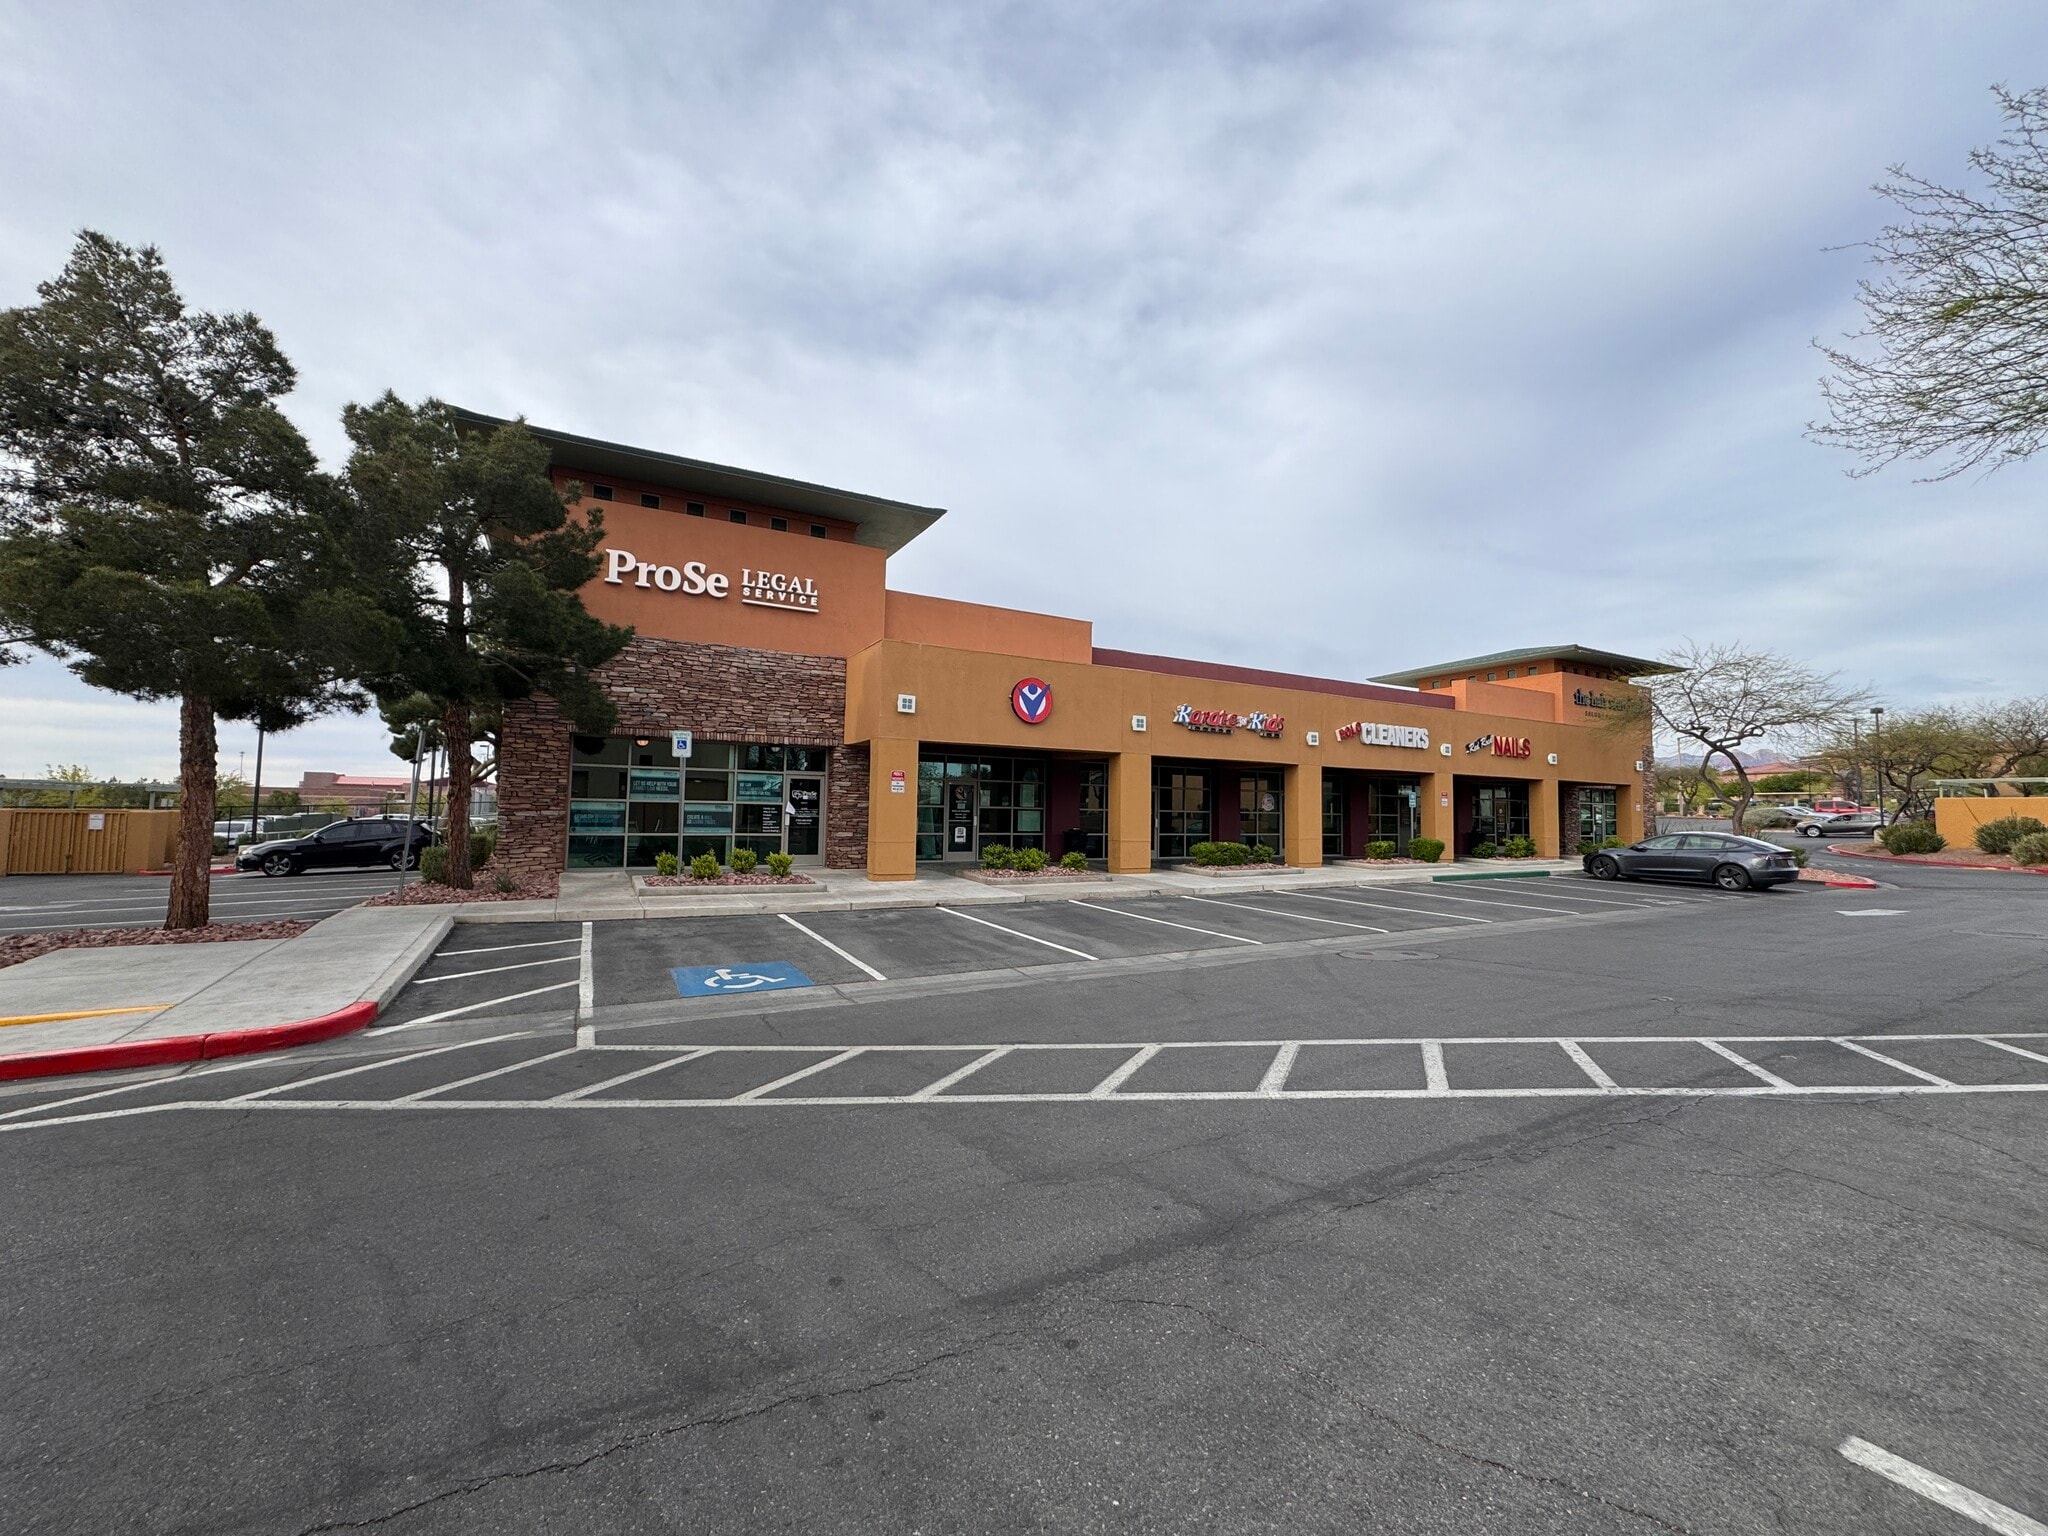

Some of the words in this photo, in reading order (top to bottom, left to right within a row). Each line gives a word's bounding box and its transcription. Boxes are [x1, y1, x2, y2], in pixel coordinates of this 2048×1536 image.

[604, 548, 729, 598] ProSe
[742, 568, 818, 596] LEGAL
[742, 587, 818, 606] SERVICE
[1174, 703, 1238, 727] Karate
[1247, 711, 1285, 732] Kids
[1337, 721, 1362, 741] POLO
[1361, 722, 1430, 749] CLEANERS
[1492, 735, 1531, 758] NAILS
